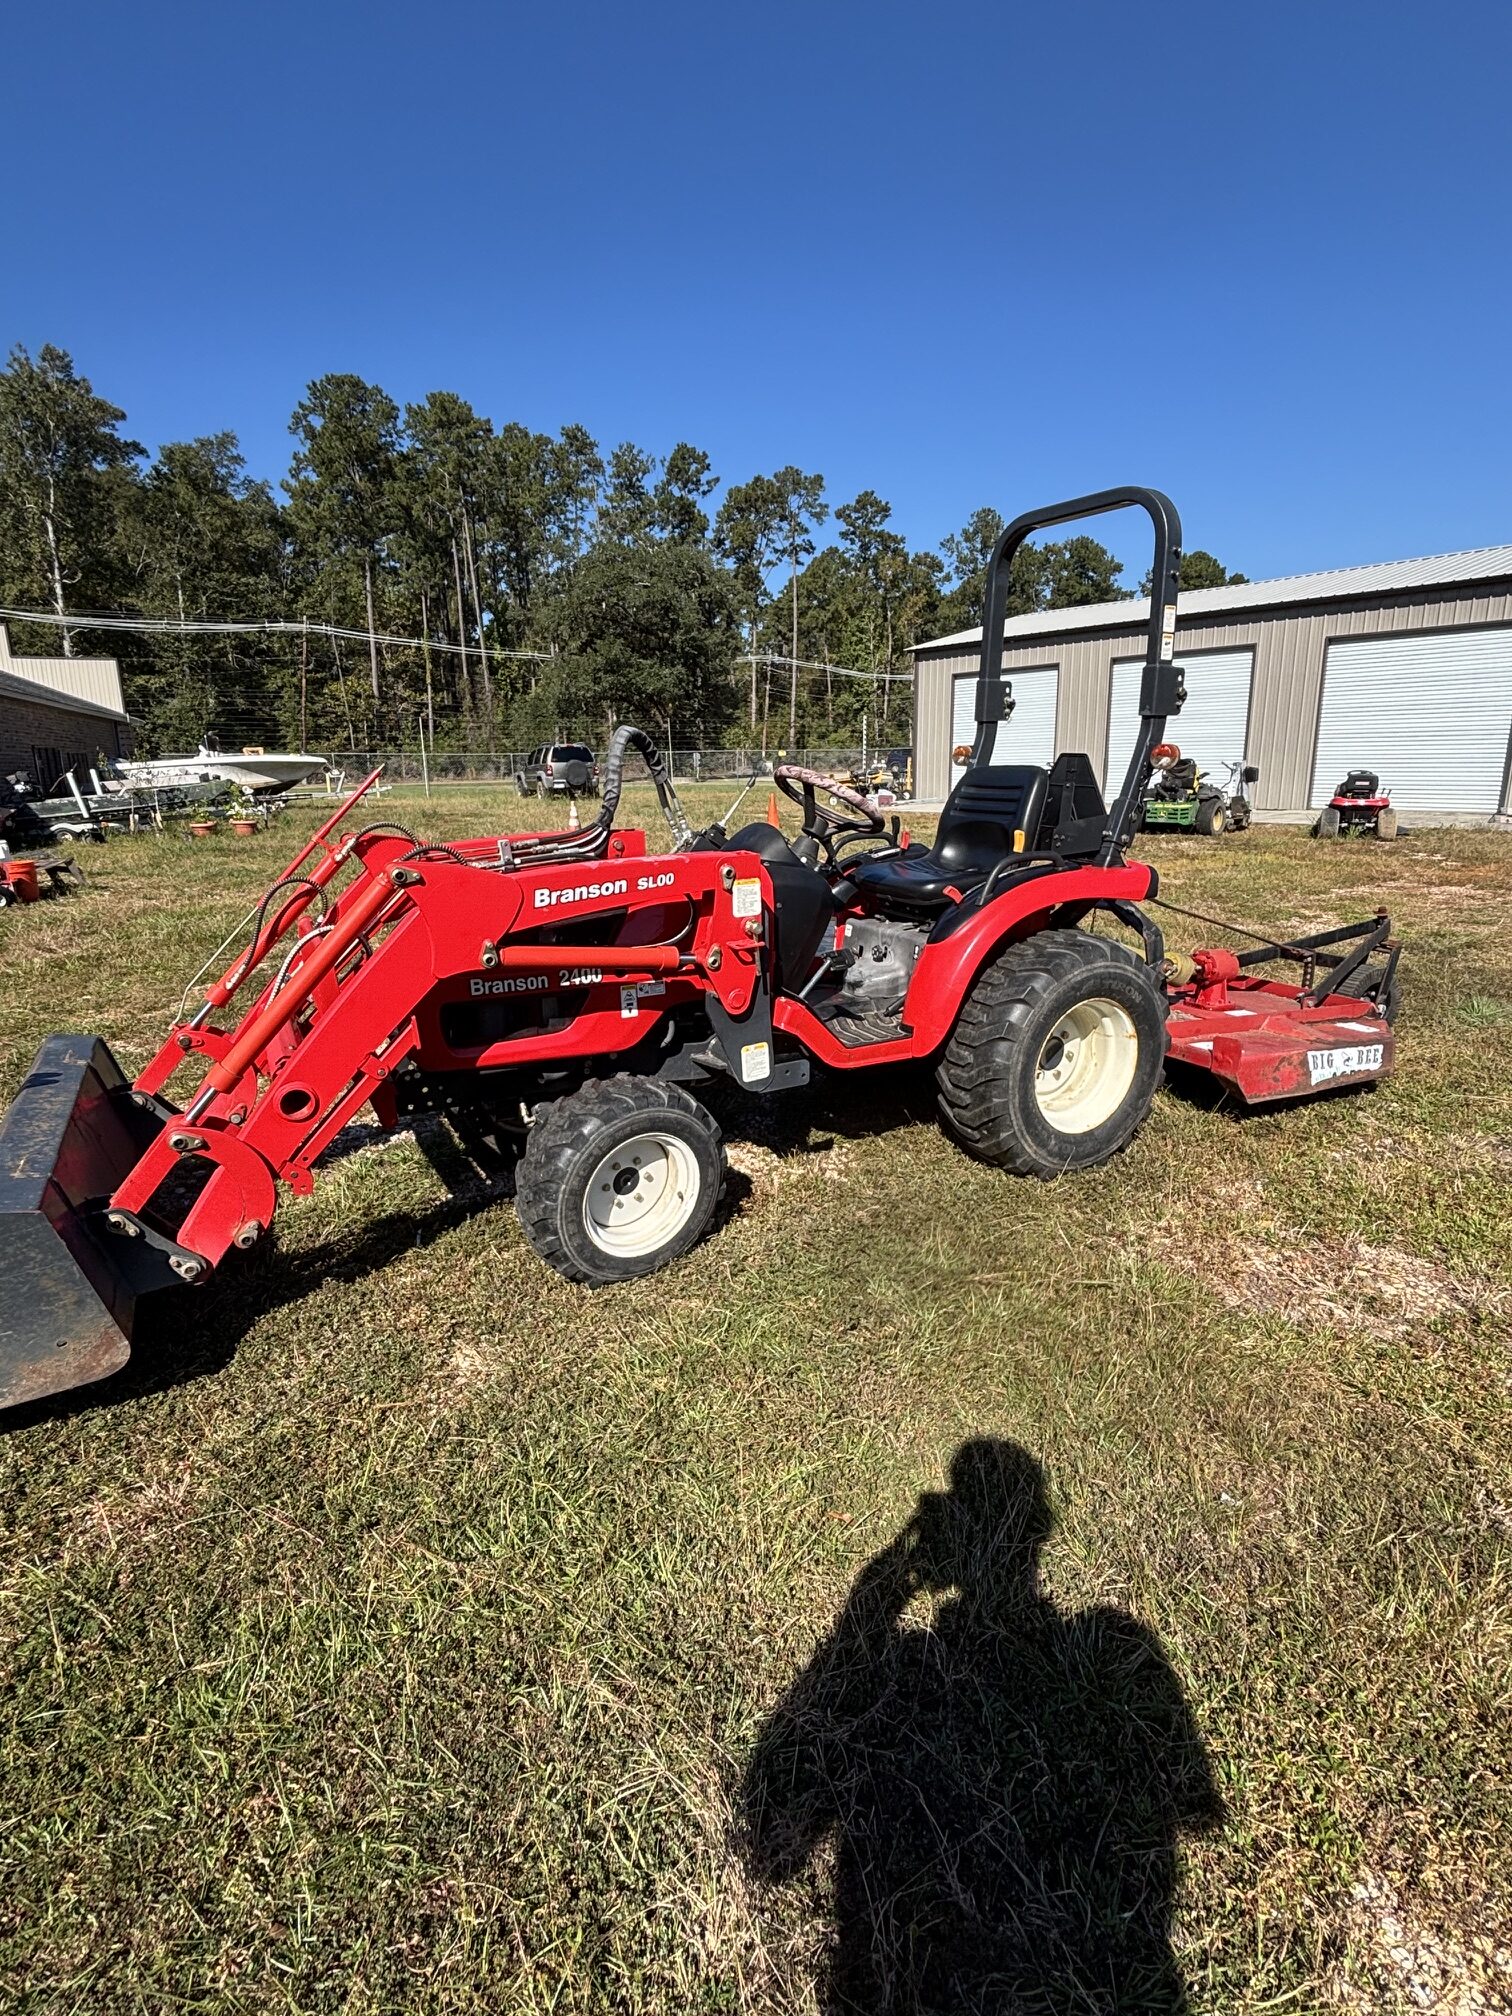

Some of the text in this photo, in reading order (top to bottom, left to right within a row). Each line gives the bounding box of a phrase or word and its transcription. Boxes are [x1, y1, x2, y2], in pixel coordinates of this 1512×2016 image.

[534, 879, 627, 908] Branson
[470, 968, 603, 996] Branson 2400
[1311, 1048, 1380, 1070] BIG BEE
